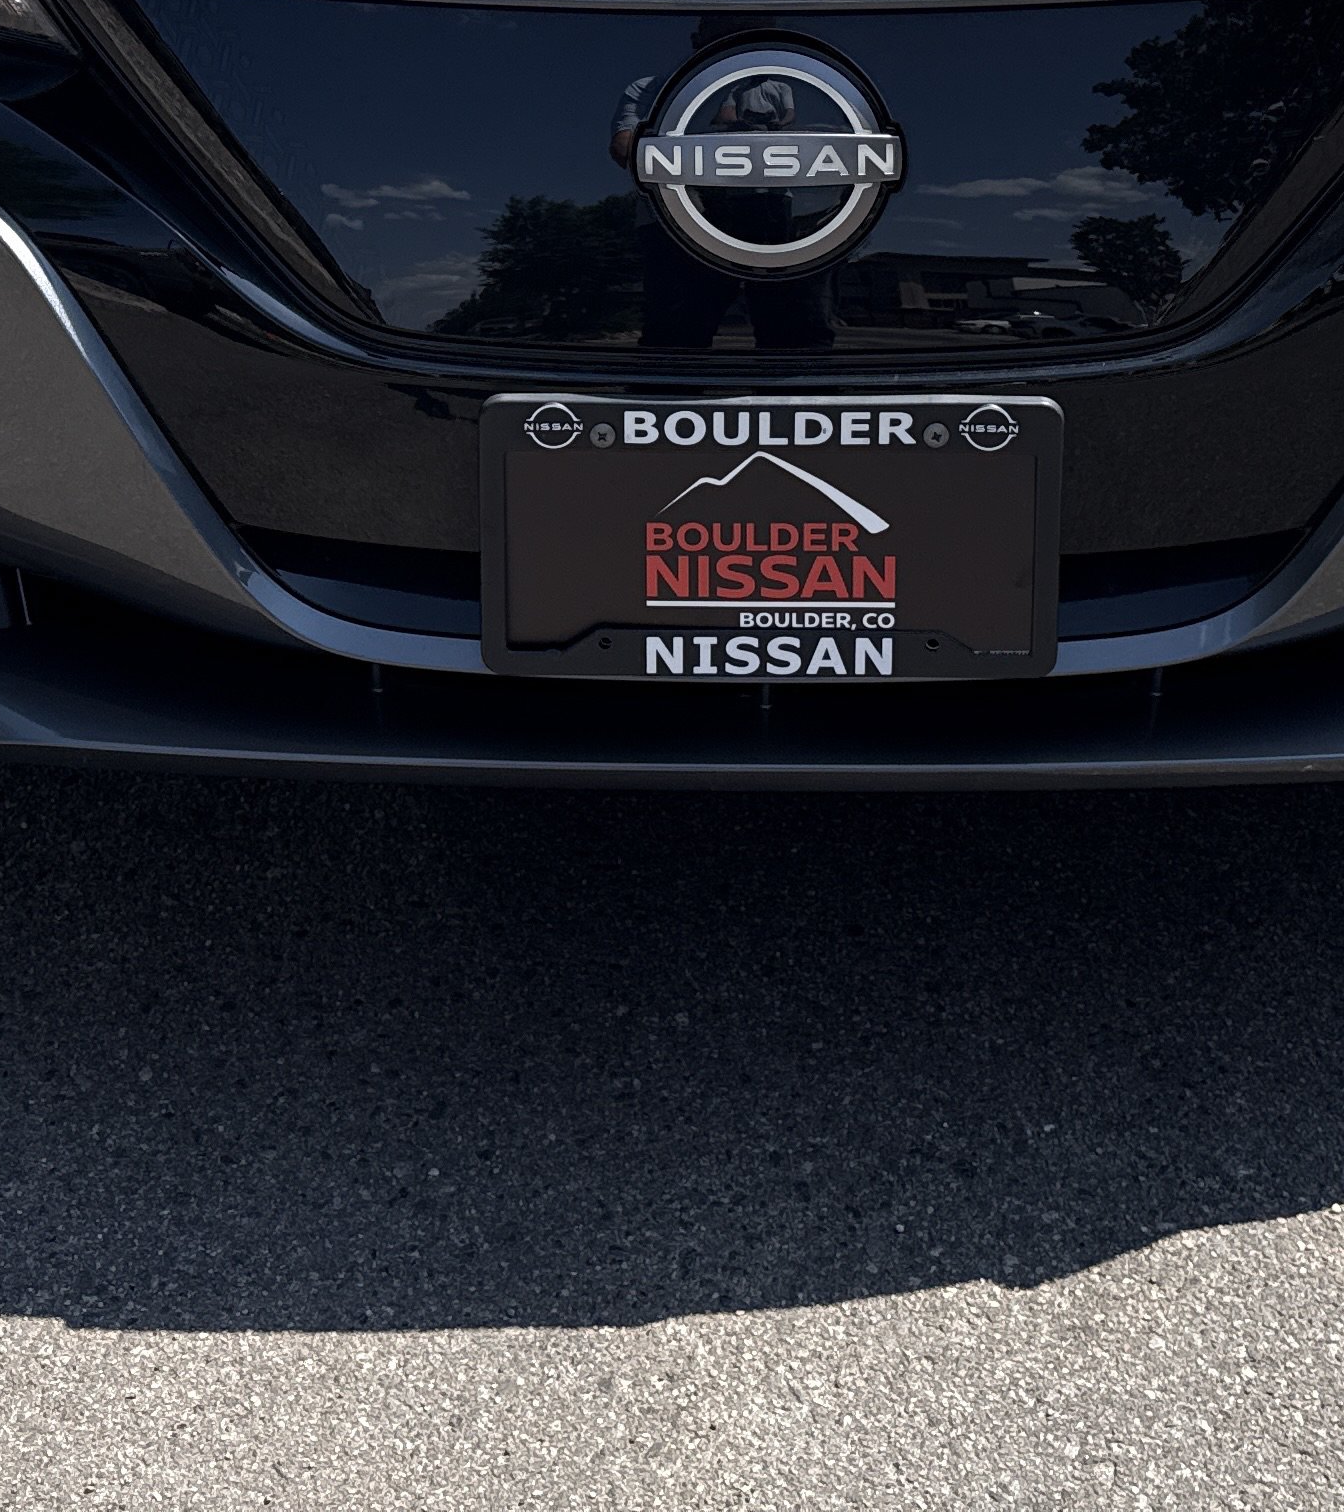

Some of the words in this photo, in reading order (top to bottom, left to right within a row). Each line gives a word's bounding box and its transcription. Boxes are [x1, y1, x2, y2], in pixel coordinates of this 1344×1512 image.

[644, 143, 895, 177] NISSAN
[523, 422, 584, 431] NISSAN
[623, 410, 916, 446] BOULDER
[958, 424, 1020, 434] NISSAN
[646, 521, 859, 552] BOULDER
[646, 554, 896, 600] NISSAN
[739, 612, 856, 631] BOULDER,
[862, 612, 895, 629] CO
[646, 635, 893, 676] NISSAN
